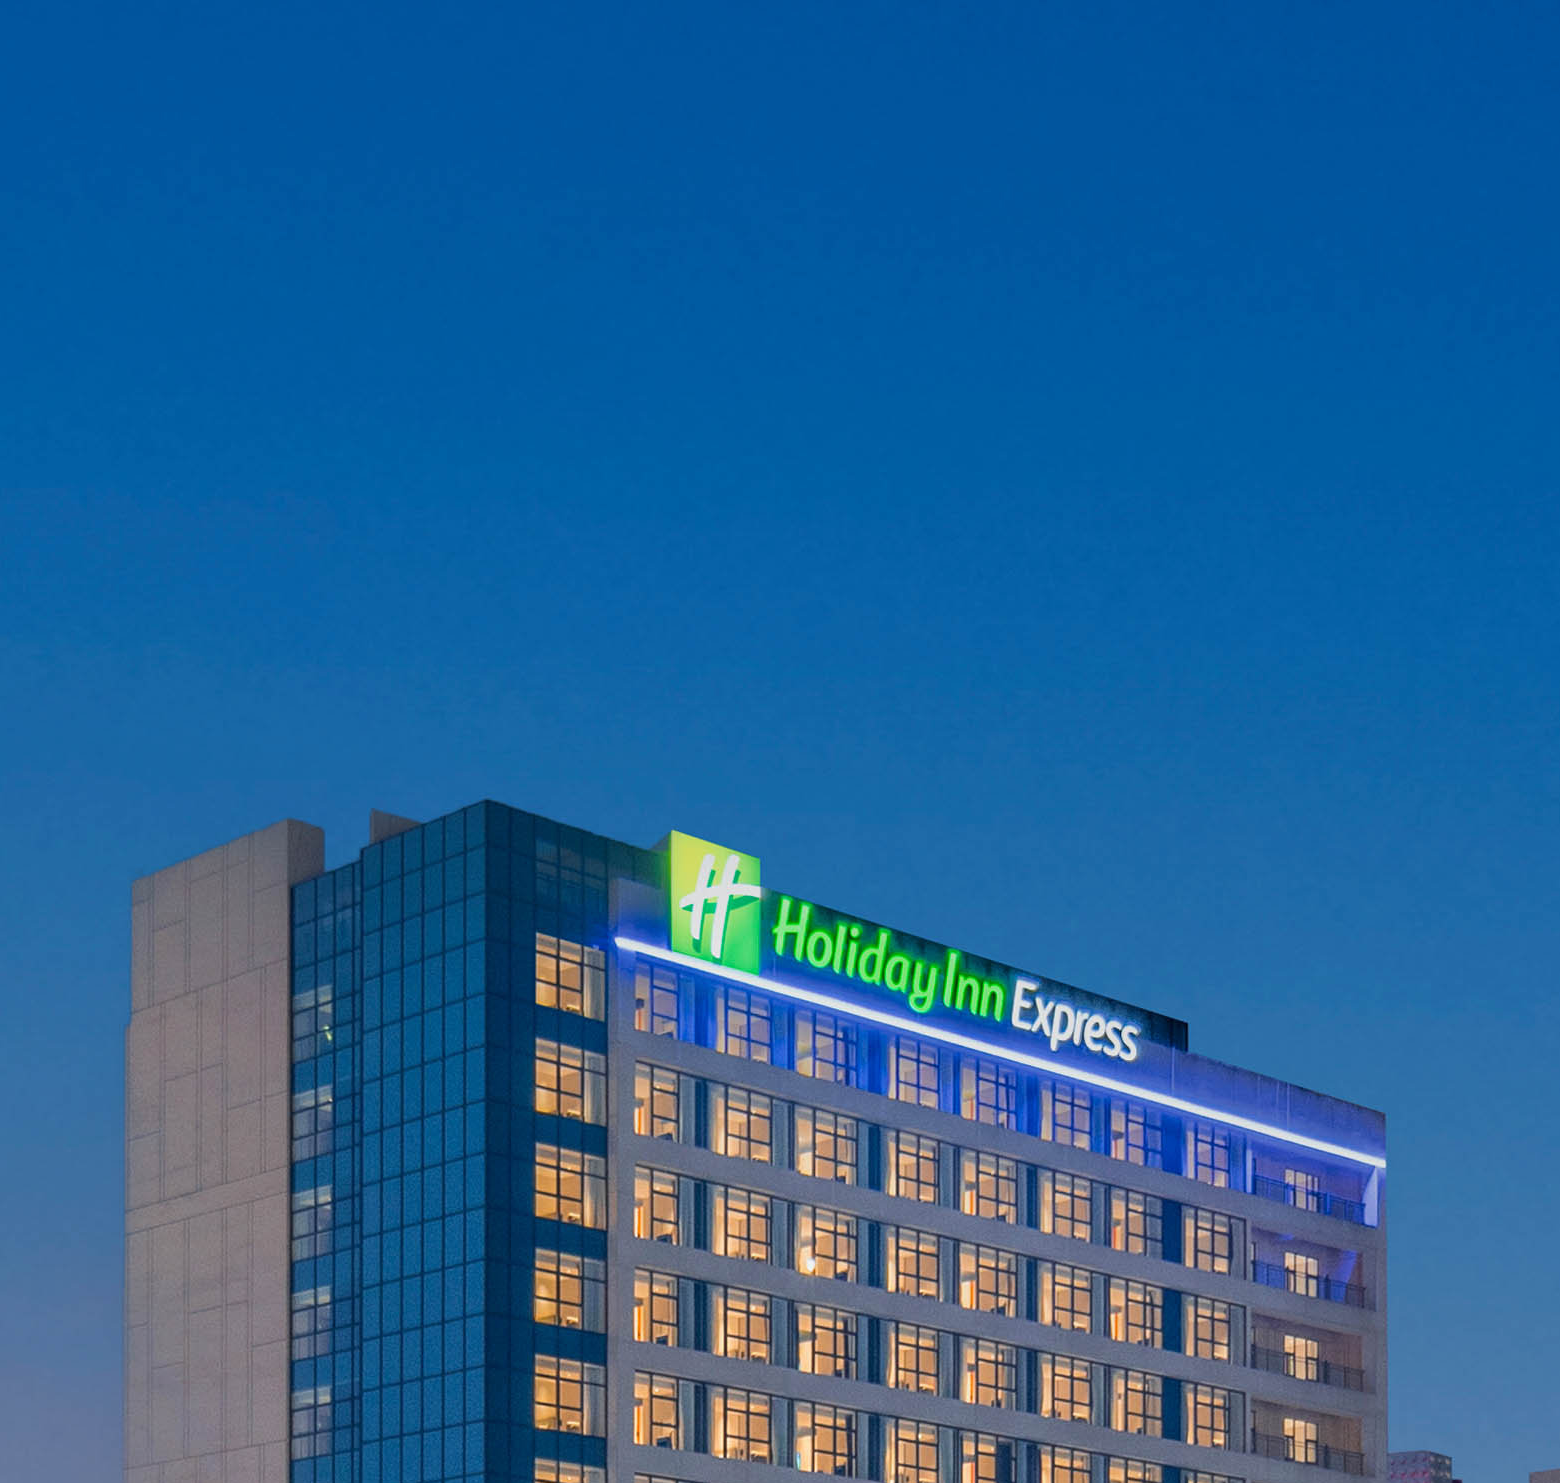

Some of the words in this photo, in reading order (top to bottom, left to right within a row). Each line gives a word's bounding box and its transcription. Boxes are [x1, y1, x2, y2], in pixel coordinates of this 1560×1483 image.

[773, 897, 938, 1014] Holiday
[942, 949, 1005, 1022] Inn
[1011, 978, 1139, 1062] Express
